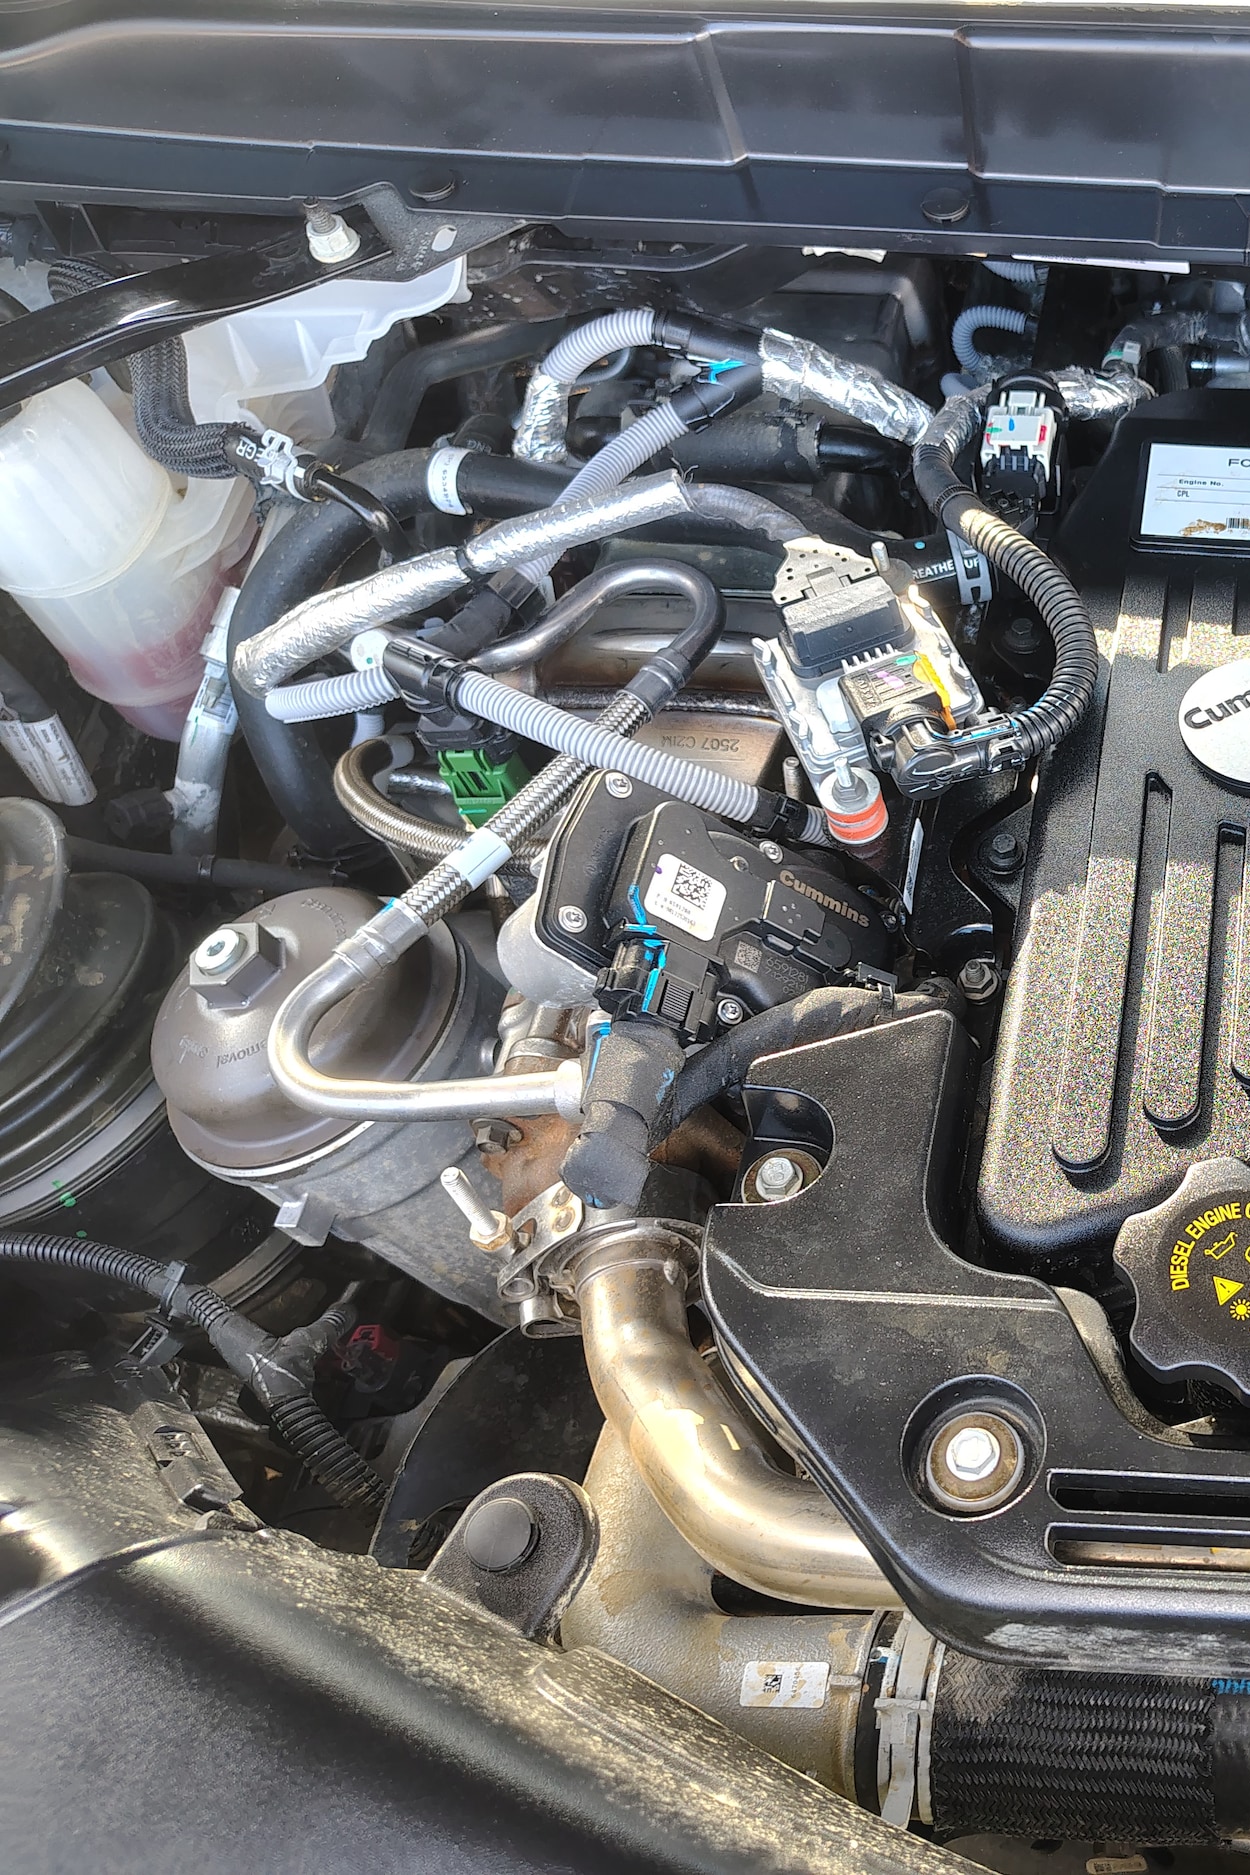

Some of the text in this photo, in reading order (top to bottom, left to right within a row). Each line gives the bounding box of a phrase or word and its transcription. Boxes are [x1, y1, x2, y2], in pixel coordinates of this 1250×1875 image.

[1179, 479, 1207, 487] Engine
[779, 869, 871, 928] Cummins
[1169, 1240, 1196, 1291] DIESEL
[1185, 1202, 1242, 1240] ENGINE
